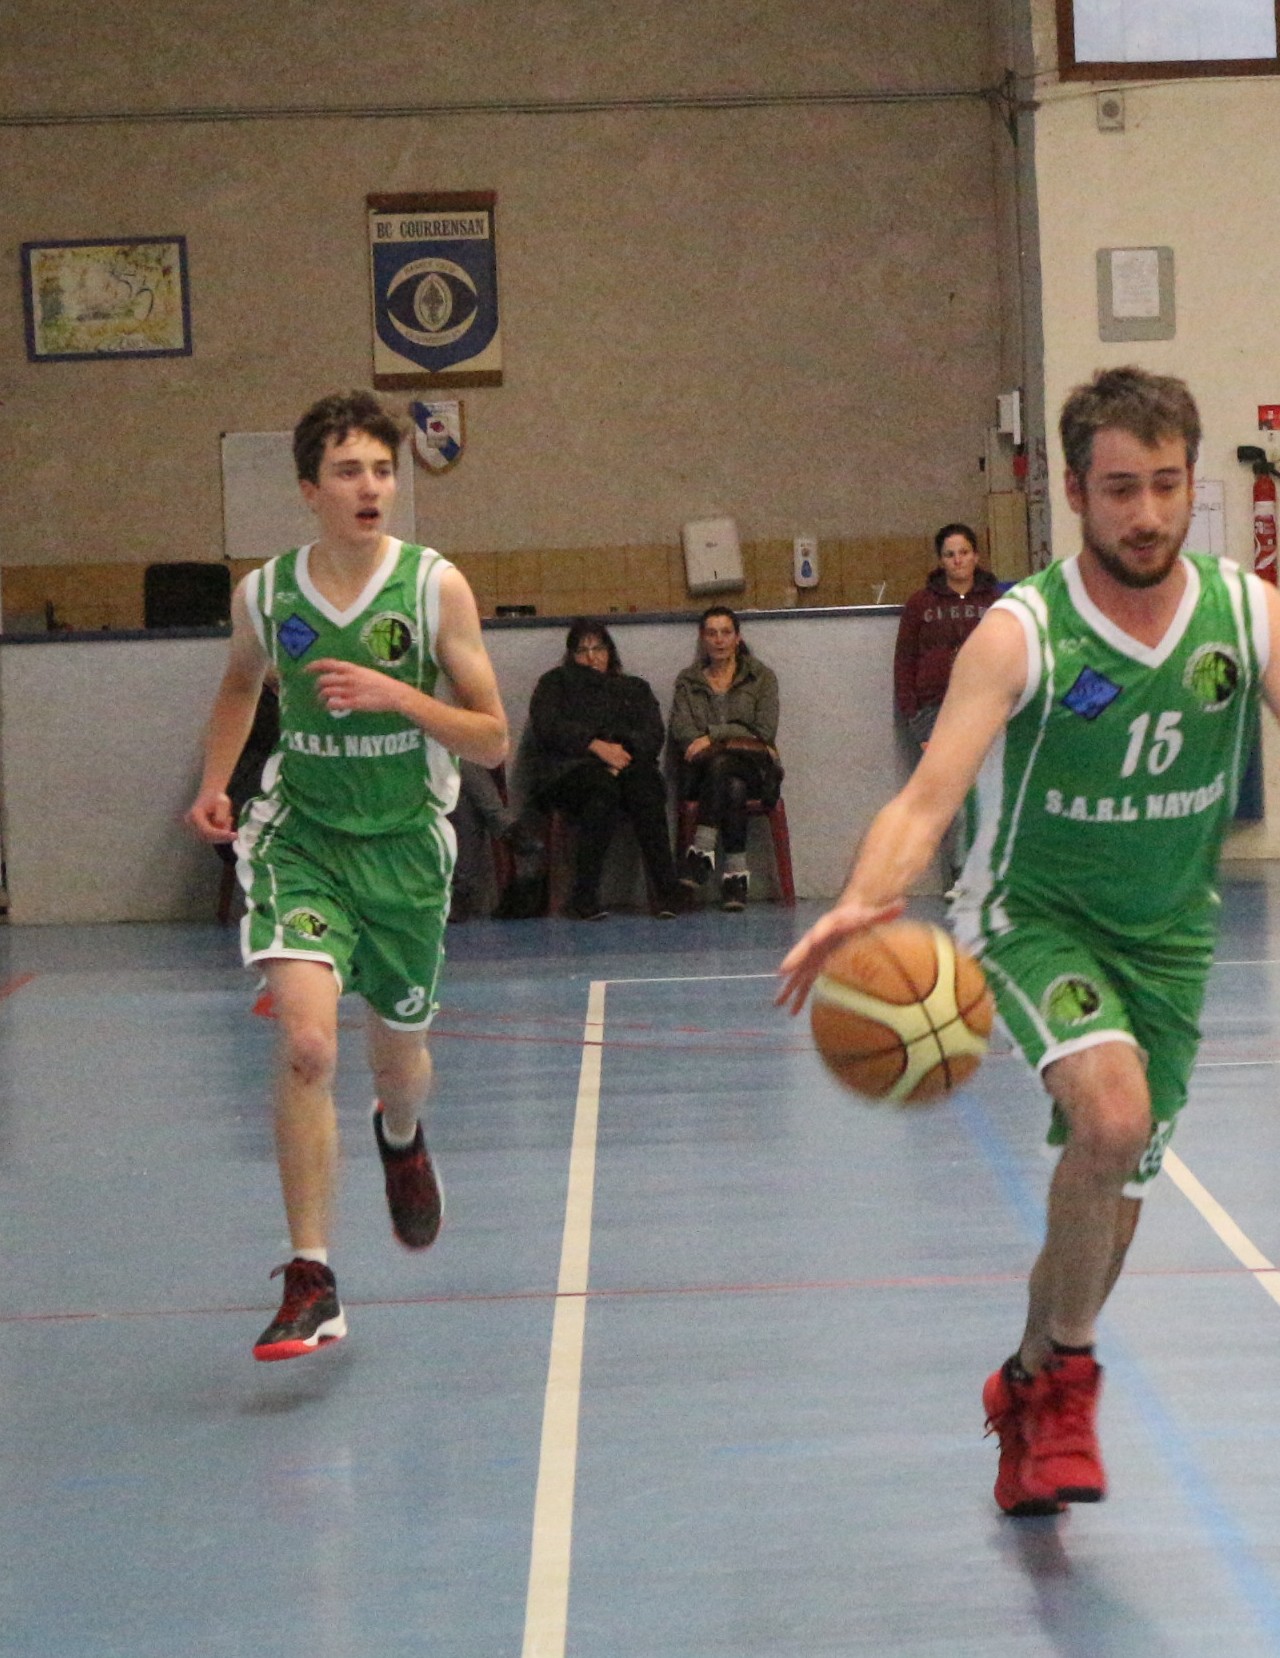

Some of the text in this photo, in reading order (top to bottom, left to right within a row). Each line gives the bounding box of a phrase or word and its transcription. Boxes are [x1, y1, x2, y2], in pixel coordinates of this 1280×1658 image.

[376, 218, 484, 239] BC COURRENSAN
[1121, 711, 1183, 778] 15
[395, 986, 425, 1017] 8
